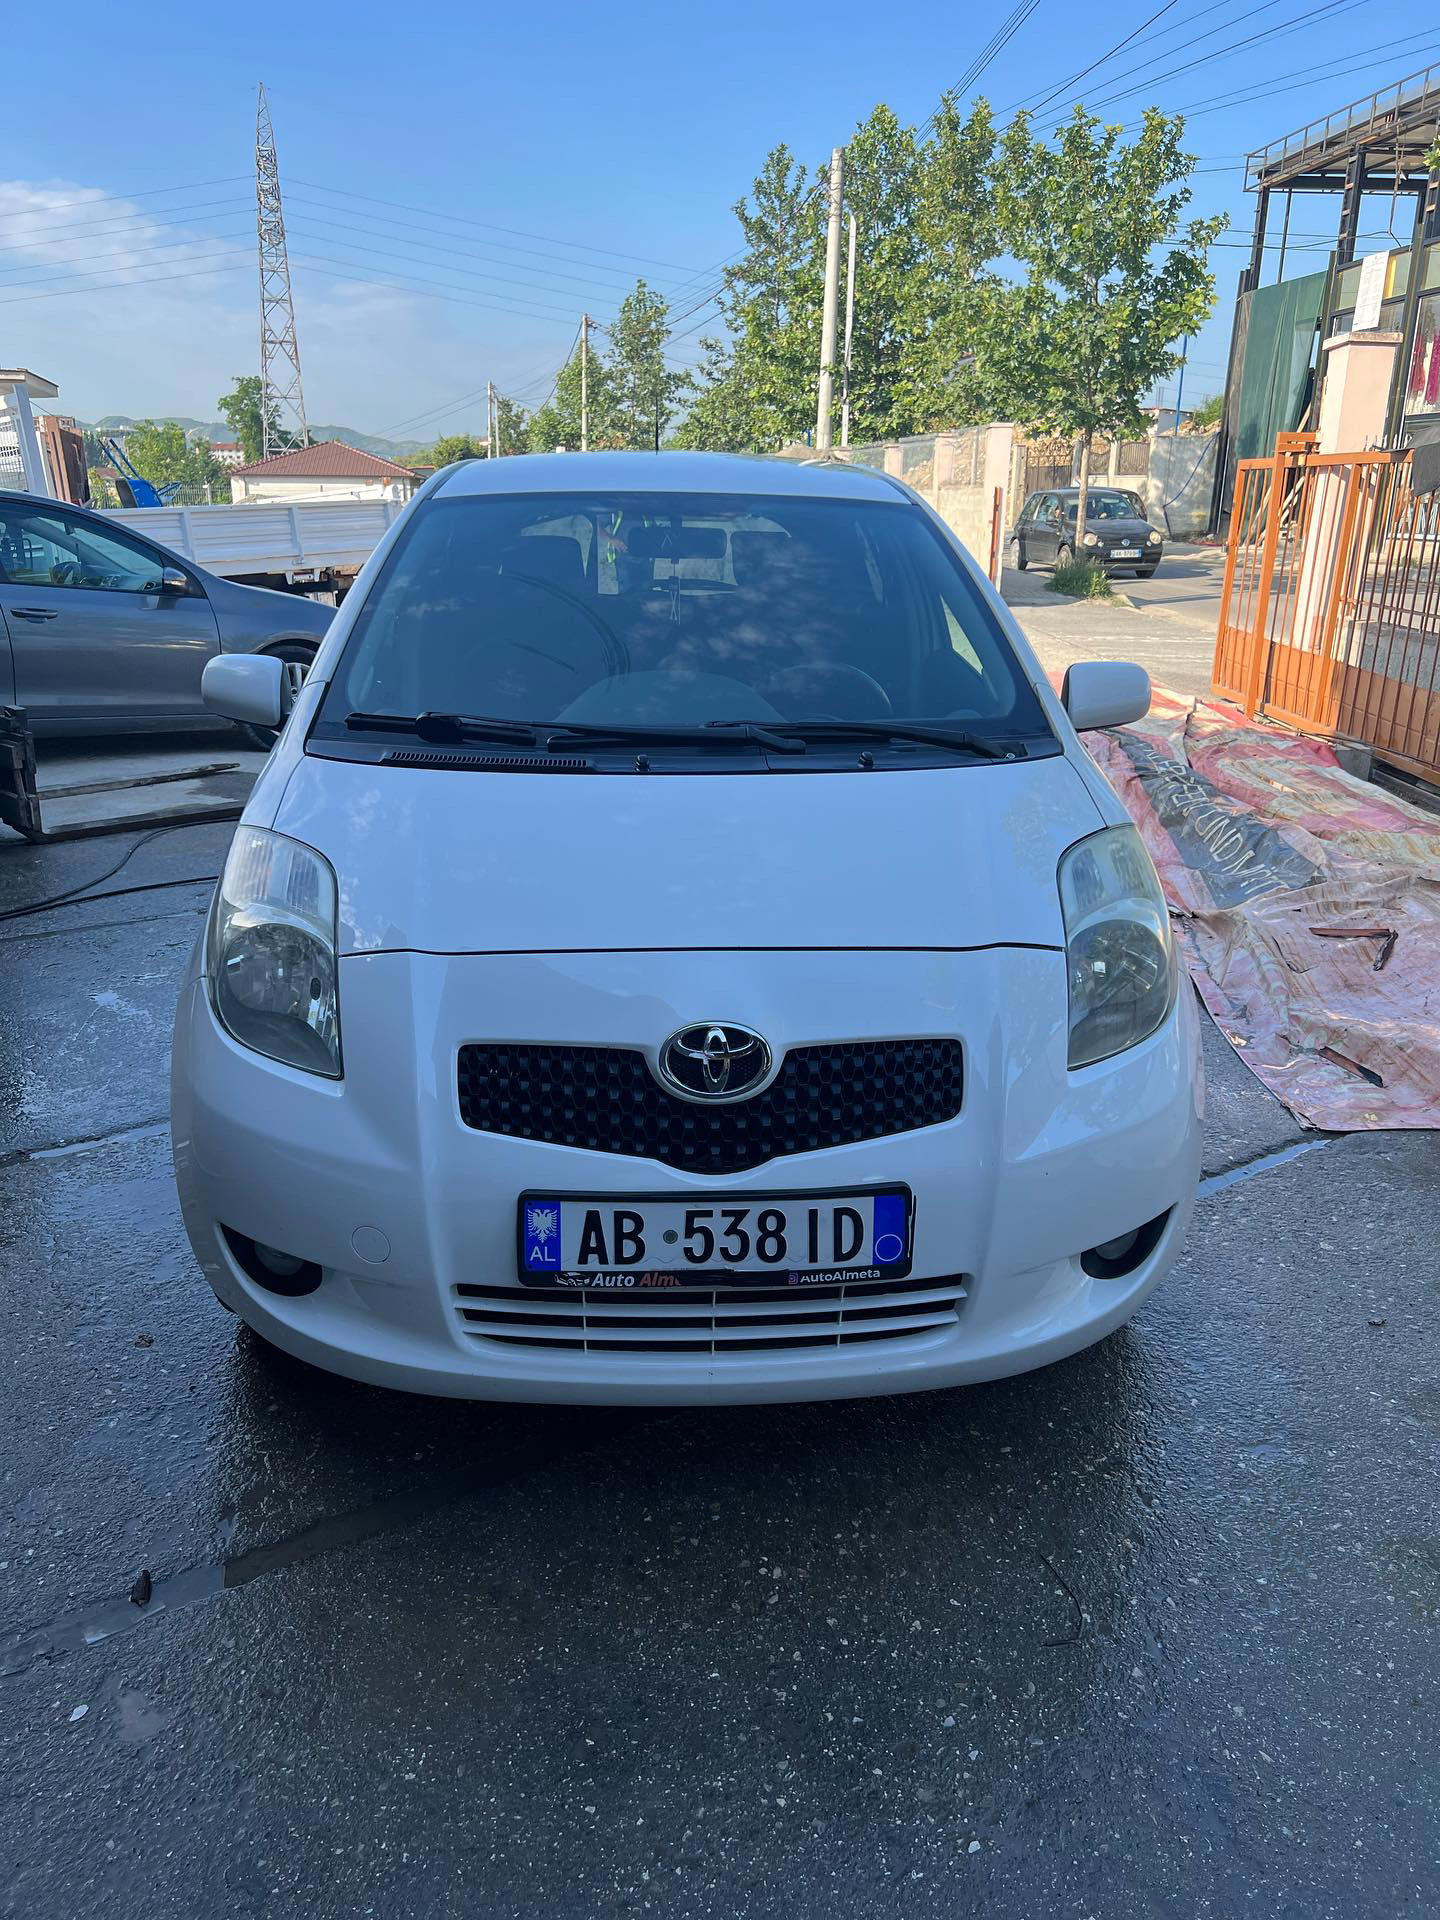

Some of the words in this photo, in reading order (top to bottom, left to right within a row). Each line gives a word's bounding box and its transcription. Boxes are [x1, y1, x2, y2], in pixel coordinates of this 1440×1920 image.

[577, 1209, 646, 1265] AB
[682, 1208, 788, 1264] 538
[807, 1206, 865, 1264] ID
[529, 1246, 556, 1263] AL
[591, 1273, 635, 1287] Auto
[639, 1272, 681, 1287] Alm
[800, 1269, 881, 1283] AutoAlmeta
